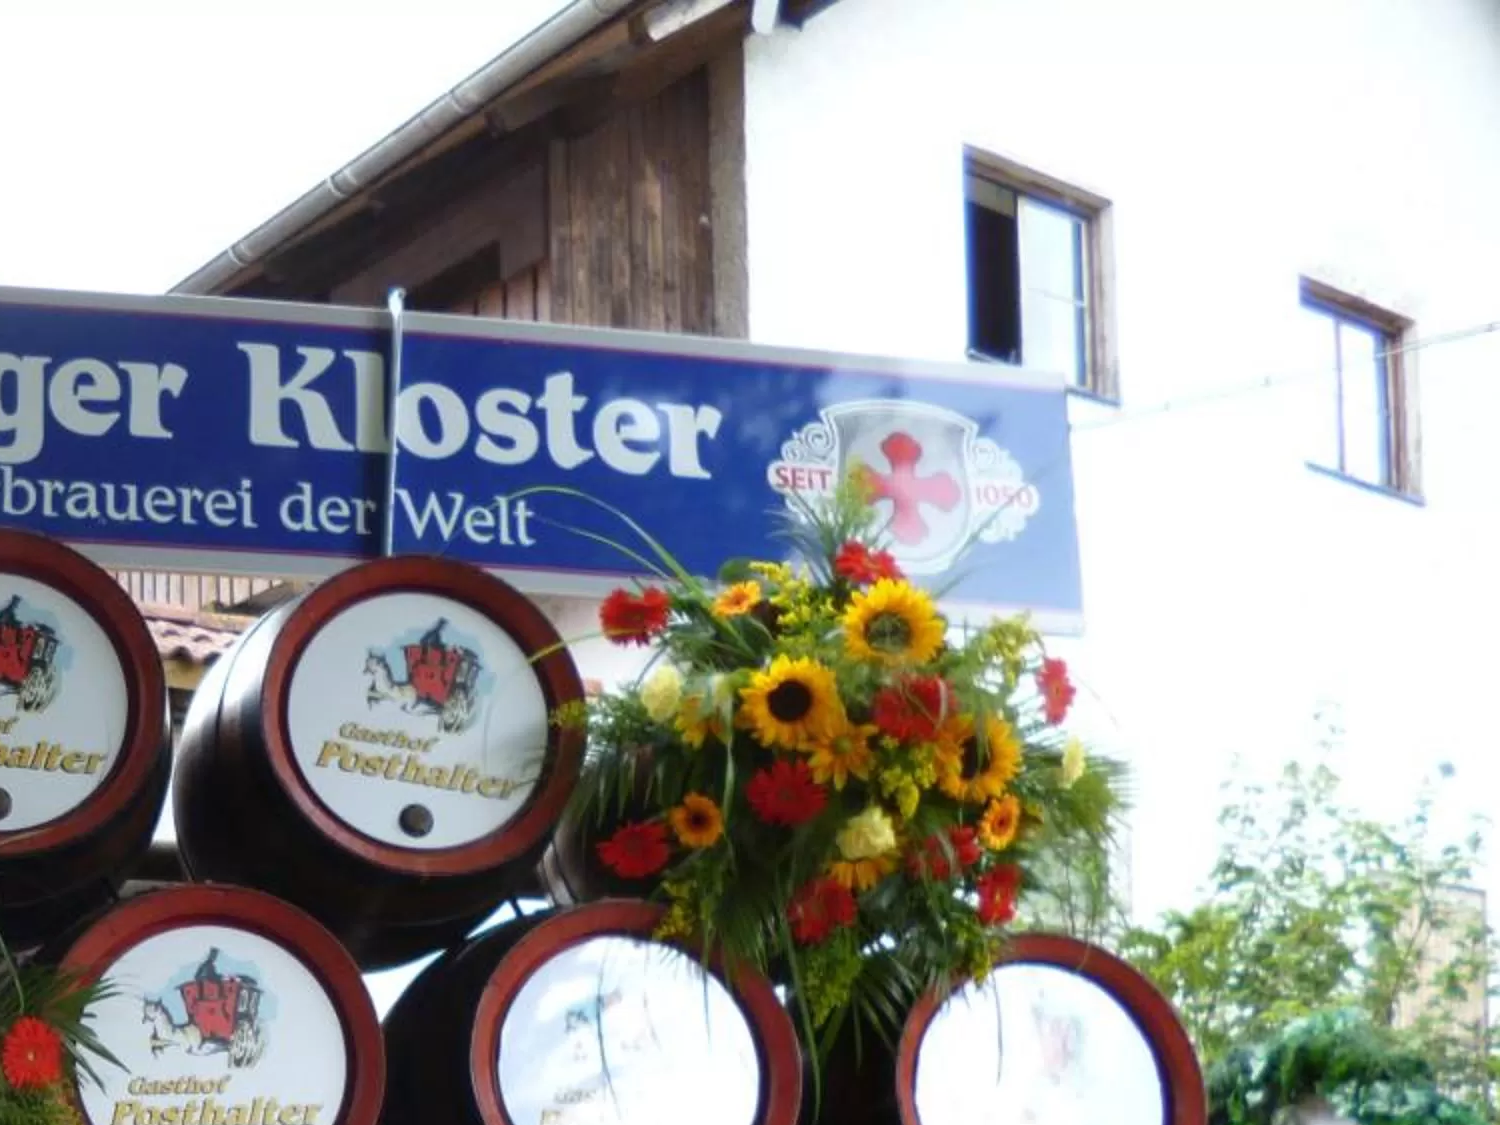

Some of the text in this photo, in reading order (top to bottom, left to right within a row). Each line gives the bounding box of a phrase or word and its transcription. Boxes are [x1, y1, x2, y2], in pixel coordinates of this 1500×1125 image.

[236, 342, 722, 479] Kloster
[280, 481, 376, 535] der
[393, 489, 536, 547] Welt
[775, 466, 1034, 509] SEIT 1050
[316, 740, 518, 799] Posthalter
[127, 1075, 232, 1096] Gasthof
